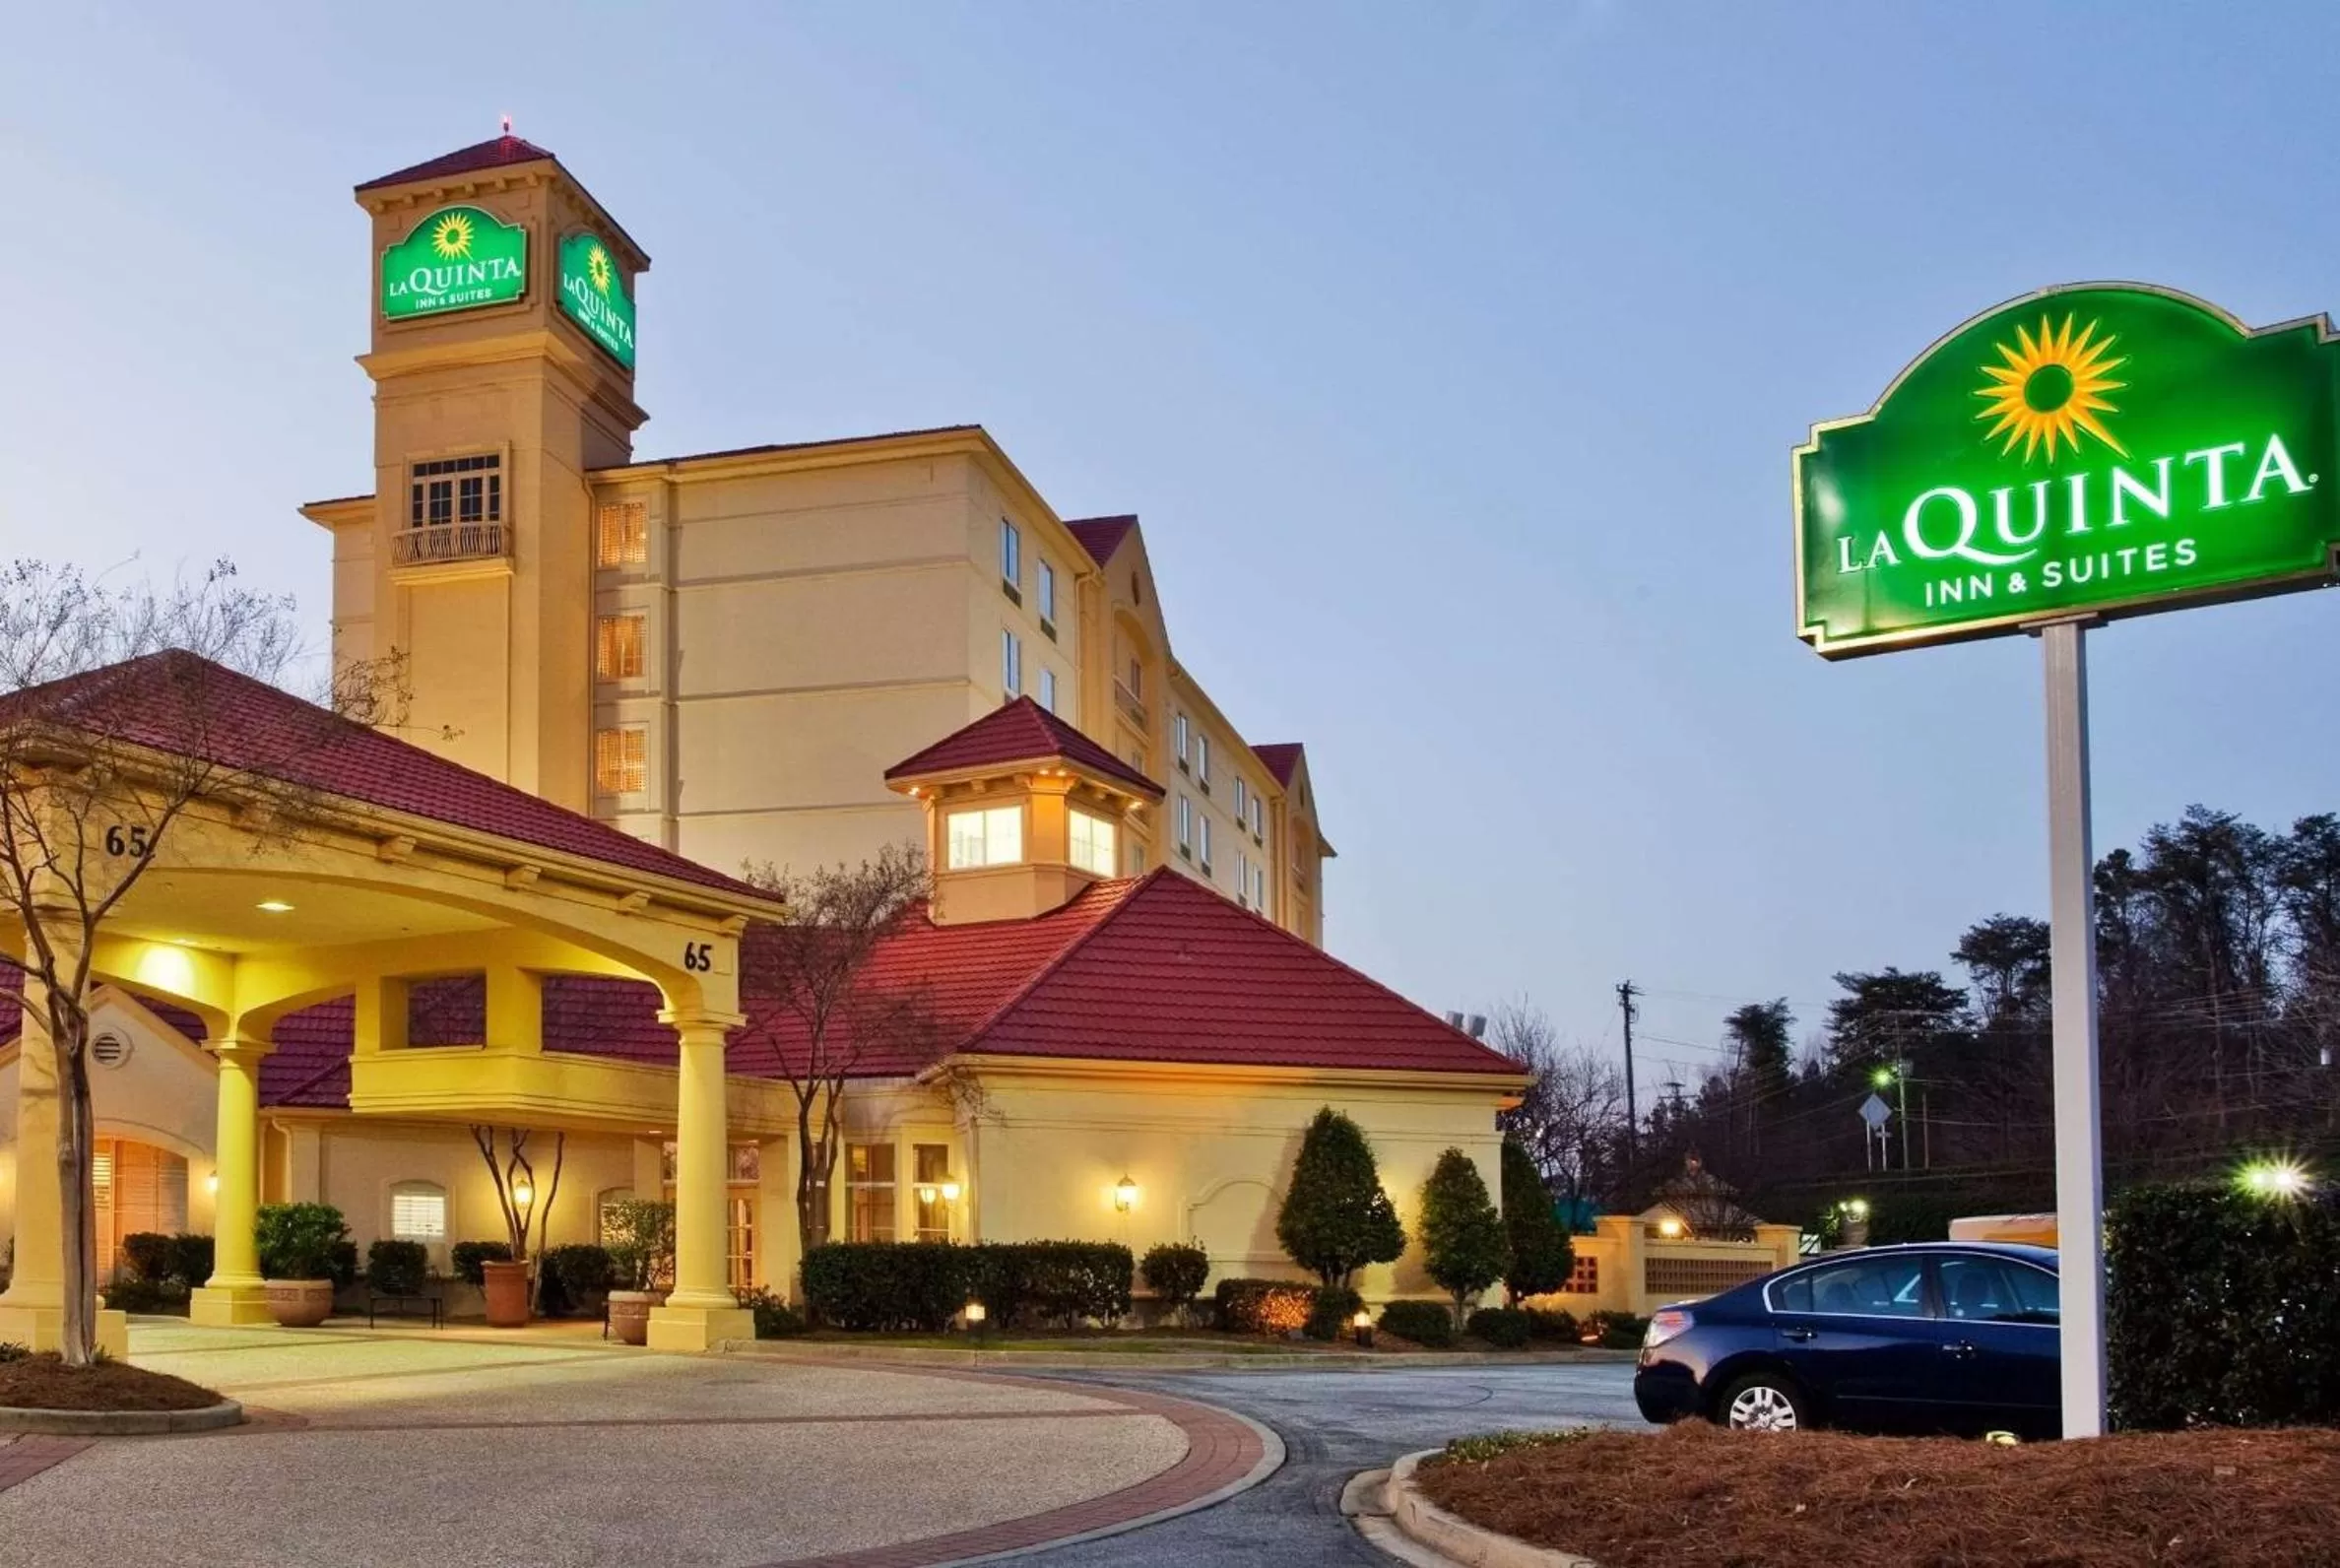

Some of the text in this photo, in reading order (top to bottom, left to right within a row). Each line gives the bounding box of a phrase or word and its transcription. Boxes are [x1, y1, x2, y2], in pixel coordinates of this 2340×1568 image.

[390, 256, 522, 296] LA QUINTA
[416, 296, 436, 309] INN
[449, 288, 491, 304] SUITES
[563, 272, 575, 294] LA
[575, 277, 633, 349] QUINTA
[1838, 433, 2312, 573] LA QUINTA
[1925, 539, 2197, 607] INN & SUITES
[105, 825, 147, 857] 65
[684, 942, 712, 972] 65
